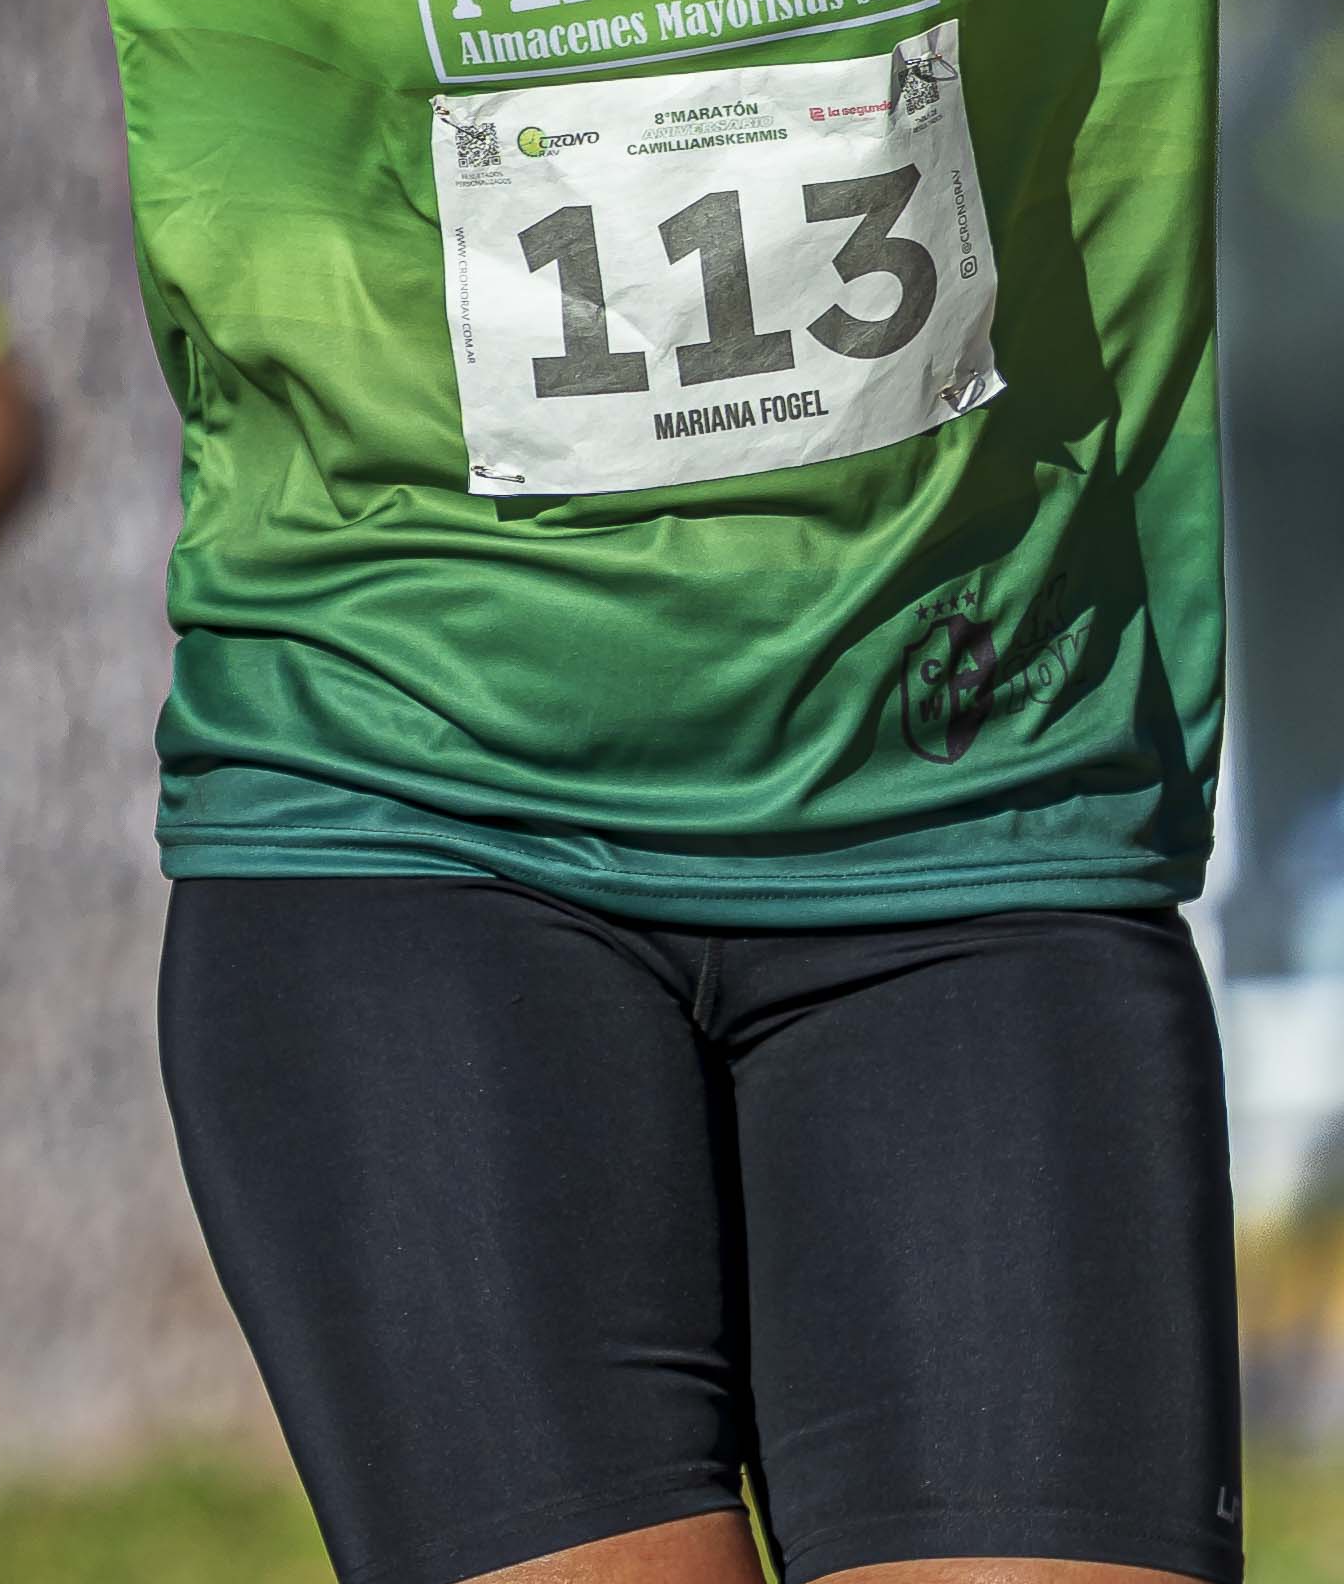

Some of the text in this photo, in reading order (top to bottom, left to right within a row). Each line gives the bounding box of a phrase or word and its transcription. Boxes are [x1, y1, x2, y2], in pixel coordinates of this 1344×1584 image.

[459, 11, 648, 66] Almacenes
[539, 132, 599, 149] CRONO
[627, 128, 788, 155] CAWILLIAMSKEMMIS
[952, 169, 972, 254] @CRONORAV
[518, 163, 938, 398] 113
[653, 390, 829, 440] MARIANA FOGEL
